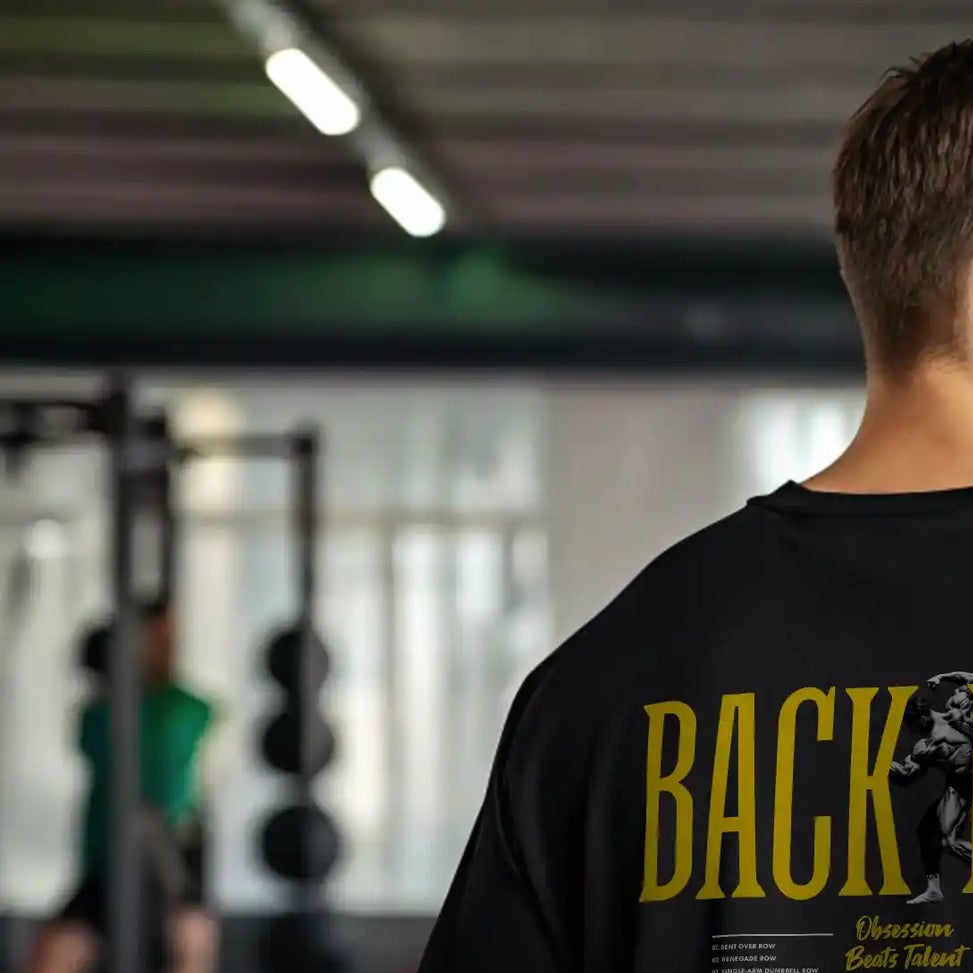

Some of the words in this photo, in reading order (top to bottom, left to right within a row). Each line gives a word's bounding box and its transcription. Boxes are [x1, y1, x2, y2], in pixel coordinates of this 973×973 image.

[639, 686, 920, 902] BACK
[856, 915, 954, 941] Obsession
[845, 945, 899, 971] Beats
[903, 944, 971, 969] Talent
